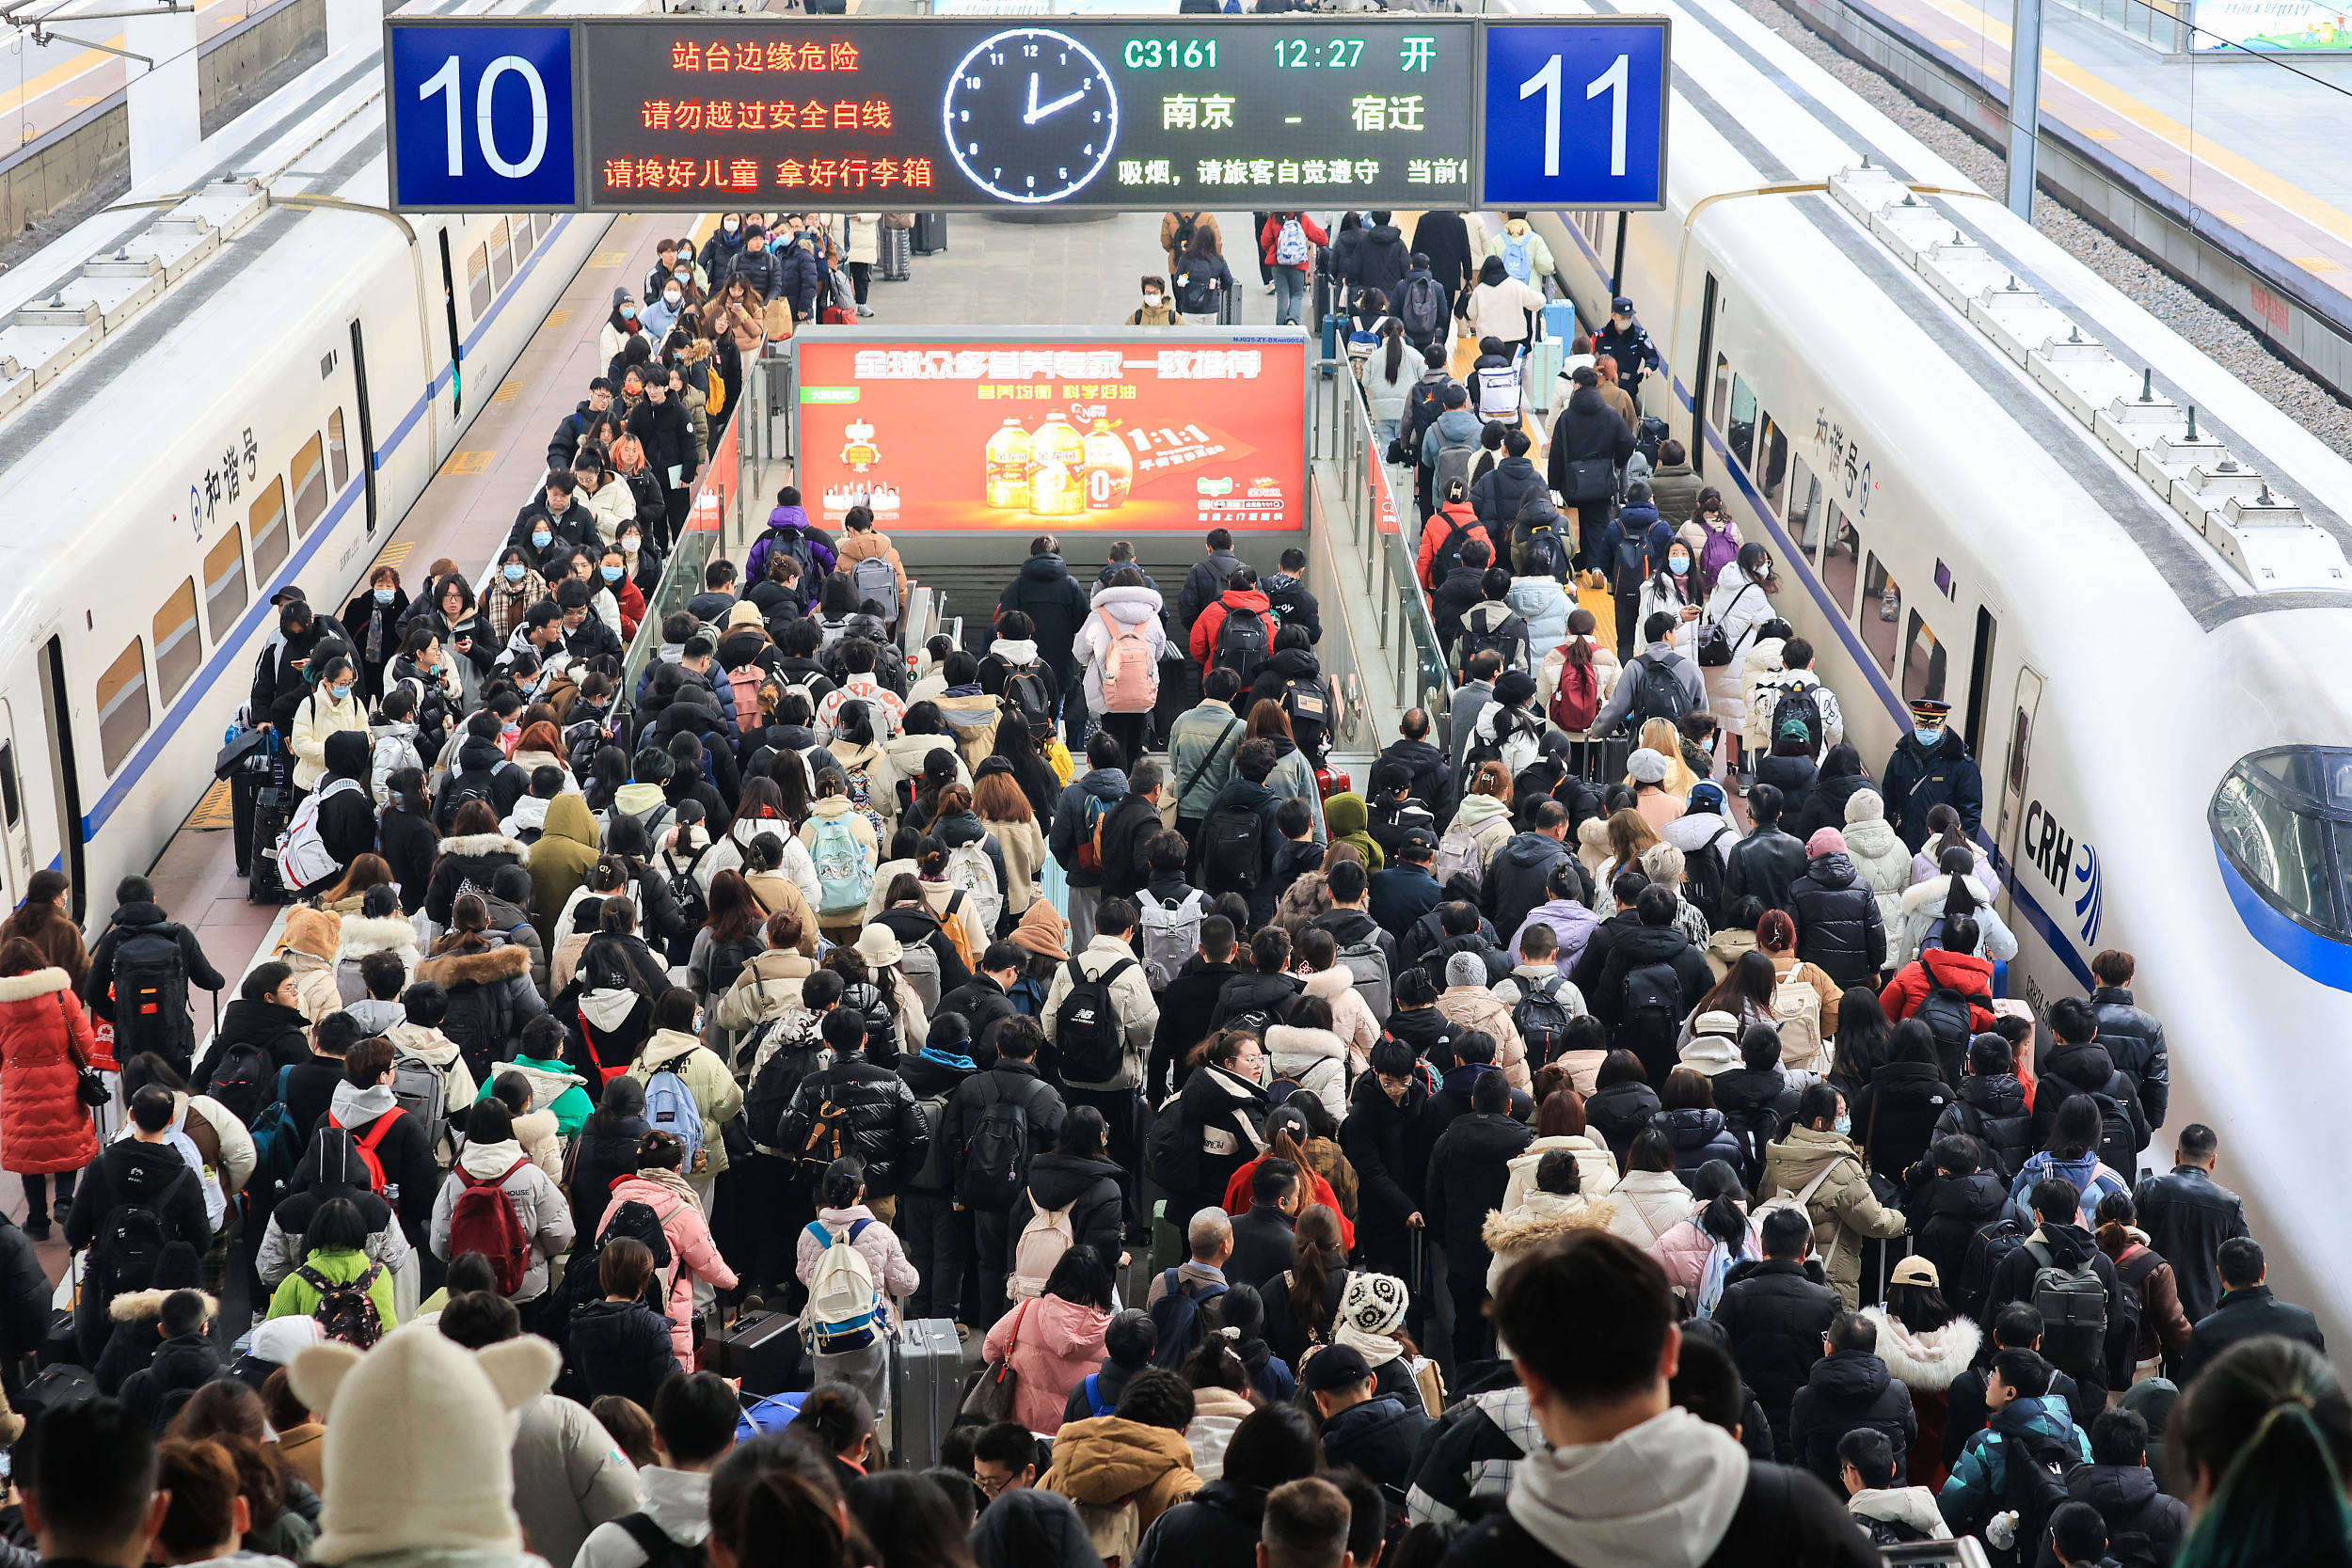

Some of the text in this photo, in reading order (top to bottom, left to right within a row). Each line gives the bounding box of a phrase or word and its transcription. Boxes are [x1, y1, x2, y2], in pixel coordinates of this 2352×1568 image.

[673, 41, 859, 72] 站台边缘危险
[990, 53, 1004, 66] 11
[1023, 44, 1039, 57] 12
[1059, 53, 1066, 66] 1
[1124, 37, 1437, 72] C3161 12:27 开
[965, 76, 981, 89] 10
[1083, 77, 1091, 90] 2
[420, 55, 548, 179] 10
[641, 99, 892, 131] 请勿越过安全白线
[961, 110, 970, 122] 9
[1092, 110, 1102, 123] 3
[1162, 93, 1236, 131] 南京
[1351, 94, 1425, 132] 宿迁
[1519, 55, 1629, 176] 11
[969, 142, 978, 155] 8
[1083, 143, 1092, 156] 4
[603, 157, 931, 188] 请搀好儿童 拿好行李箱
[993, 167, 1002, 180] 7
[1026, 175, 1035, 188] 6
[1058, 167, 1068, 180] 5
[854, 350, 1262, 380] 全球众多营养专家一致推荐
[977, 384, 1136, 400] 营养均衡 科学好油
[1127, 424, 1210, 452] 1:1:1
[1814, 406, 1858, 499] 和谐号
[204, 426, 258, 524] 和谐号
[1091, 469, 1109, 502] 0
[2025, 800, 2074, 897] CRH
